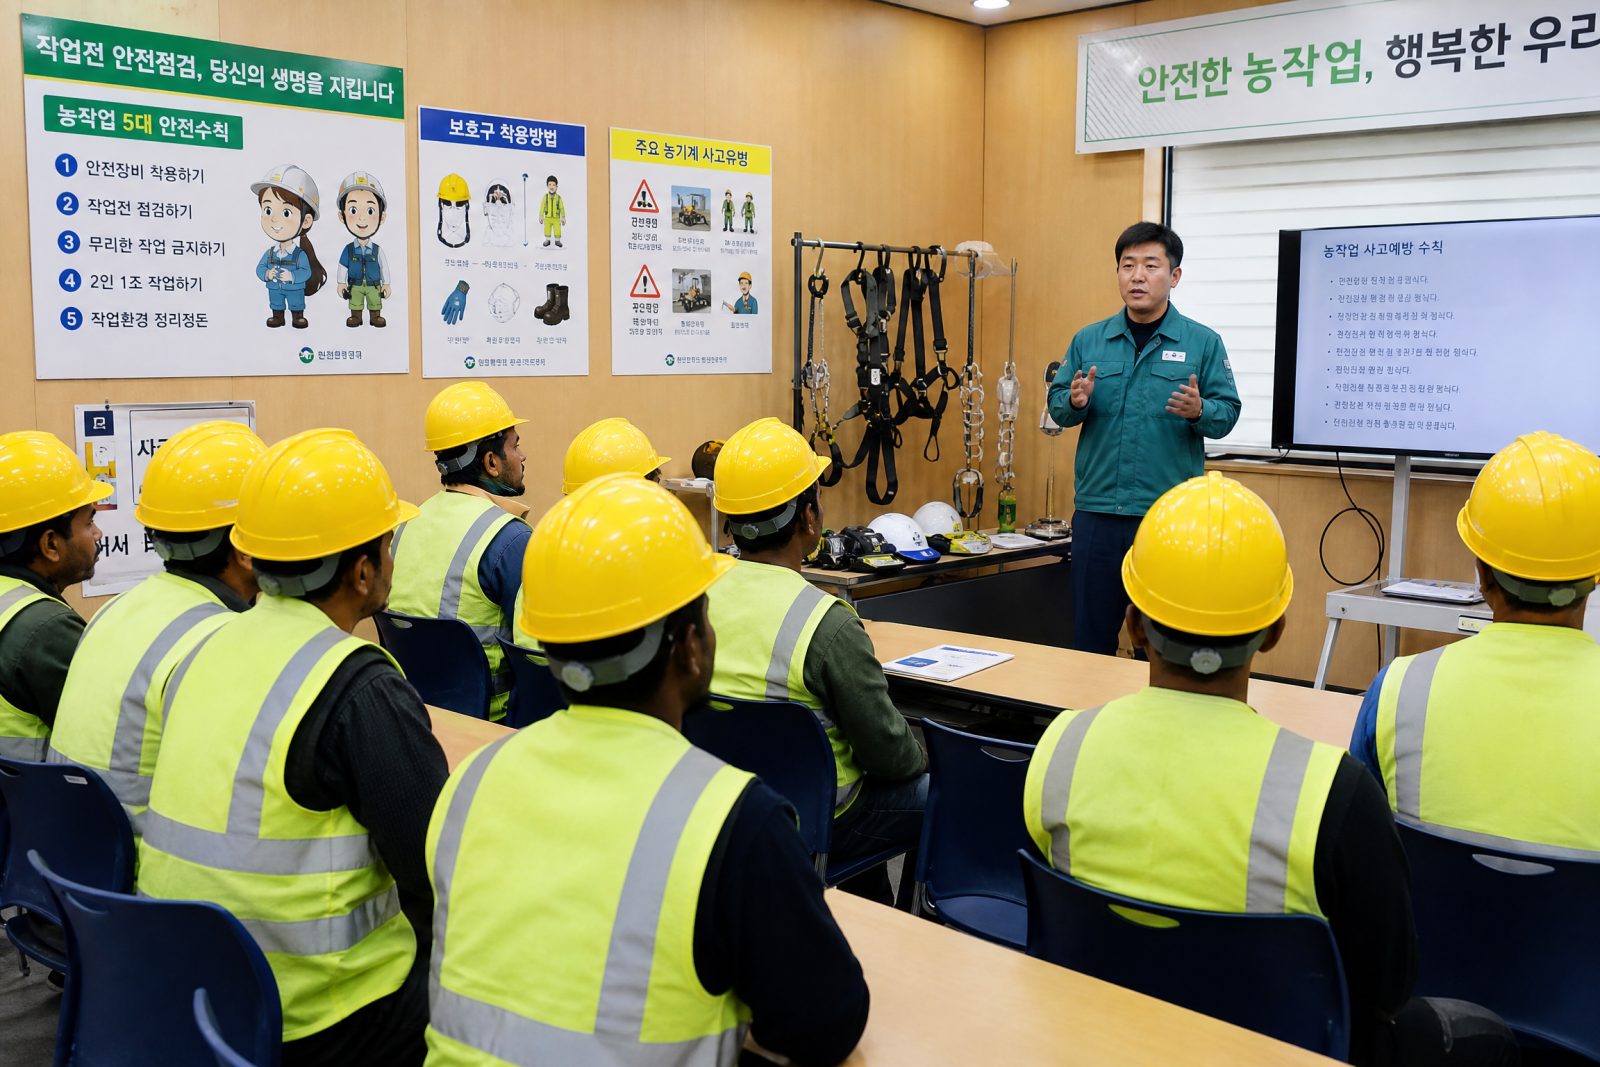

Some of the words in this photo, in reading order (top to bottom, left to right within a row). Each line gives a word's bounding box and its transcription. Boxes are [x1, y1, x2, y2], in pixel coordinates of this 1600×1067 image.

[36, 35, 104, 66] 작업전
[113, 46, 202, 81] 안전점검,
[210, 59, 264, 88] 당신의
[271, 69, 323, 95] 생명을
[329, 77, 394, 104] 지킵니다
[1138, 57, 1232, 103] 안전한
[1243, 39, 1372, 93] 농작업,
[1386, 23, 1511, 78] 행복한
[58, 105, 115, 130] 농작업
[123, 113, 152, 134] 5대
[159, 116, 229, 142] 안전수칙
[449, 119, 495, 140] 보호구
[500, 125, 557, 148] 착용방법
[636, 140, 659, 155] 주요
[664, 143, 698, 161] 농기계
[63, 159, 69, 172] 1
[87, 161, 143, 179] 안전장비
[151, 165, 203, 184] 착용하기
[63, 197, 72, 210] 2
[88, 199, 130, 216] 작업전
[137, 202, 191, 219] 점검하기
[65, 235, 73, 249] 3
[89, 237, 132, 253] 무리한
[139, 239, 165, 254] 작업
[172, 240, 224, 256] 금지하기
[1324, 244, 1358, 258] 농작업
[1364, 242, 1413, 256] 사고예방
[1419, 240, 1442, 254] 수칙
[65, 274, 75, 287] 4
[91, 275, 113, 289] 2인
[121, 276, 142, 289] 1조
[149, 276, 201, 291] 작업하기
[68, 312, 76, 326] 5
[92, 312, 147, 328] 작업환경
[155, 313, 208, 328] 정리정돈
